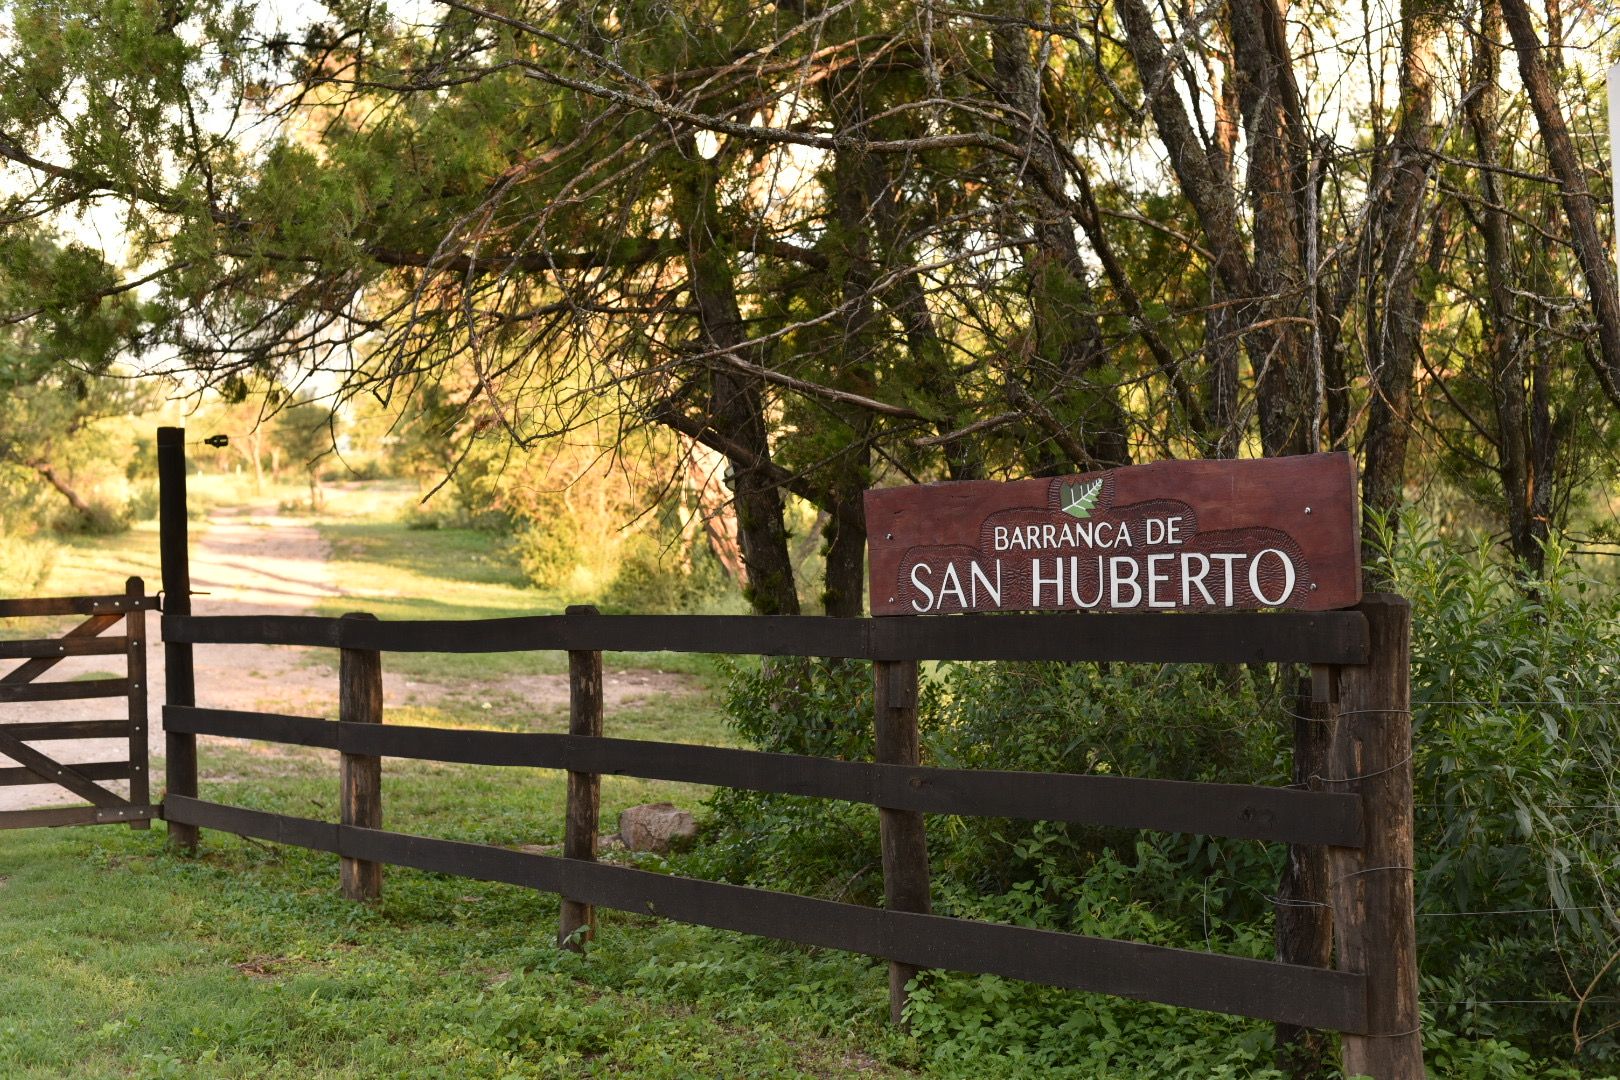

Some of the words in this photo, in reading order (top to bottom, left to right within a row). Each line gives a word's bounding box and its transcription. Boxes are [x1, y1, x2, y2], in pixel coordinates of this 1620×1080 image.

[994, 521, 1133, 551] BARRANCA
[1146, 516, 1184, 545] DE
[910, 557, 1001, 613] SAN
[1032, 548, 1297, 608] HUBERTO
